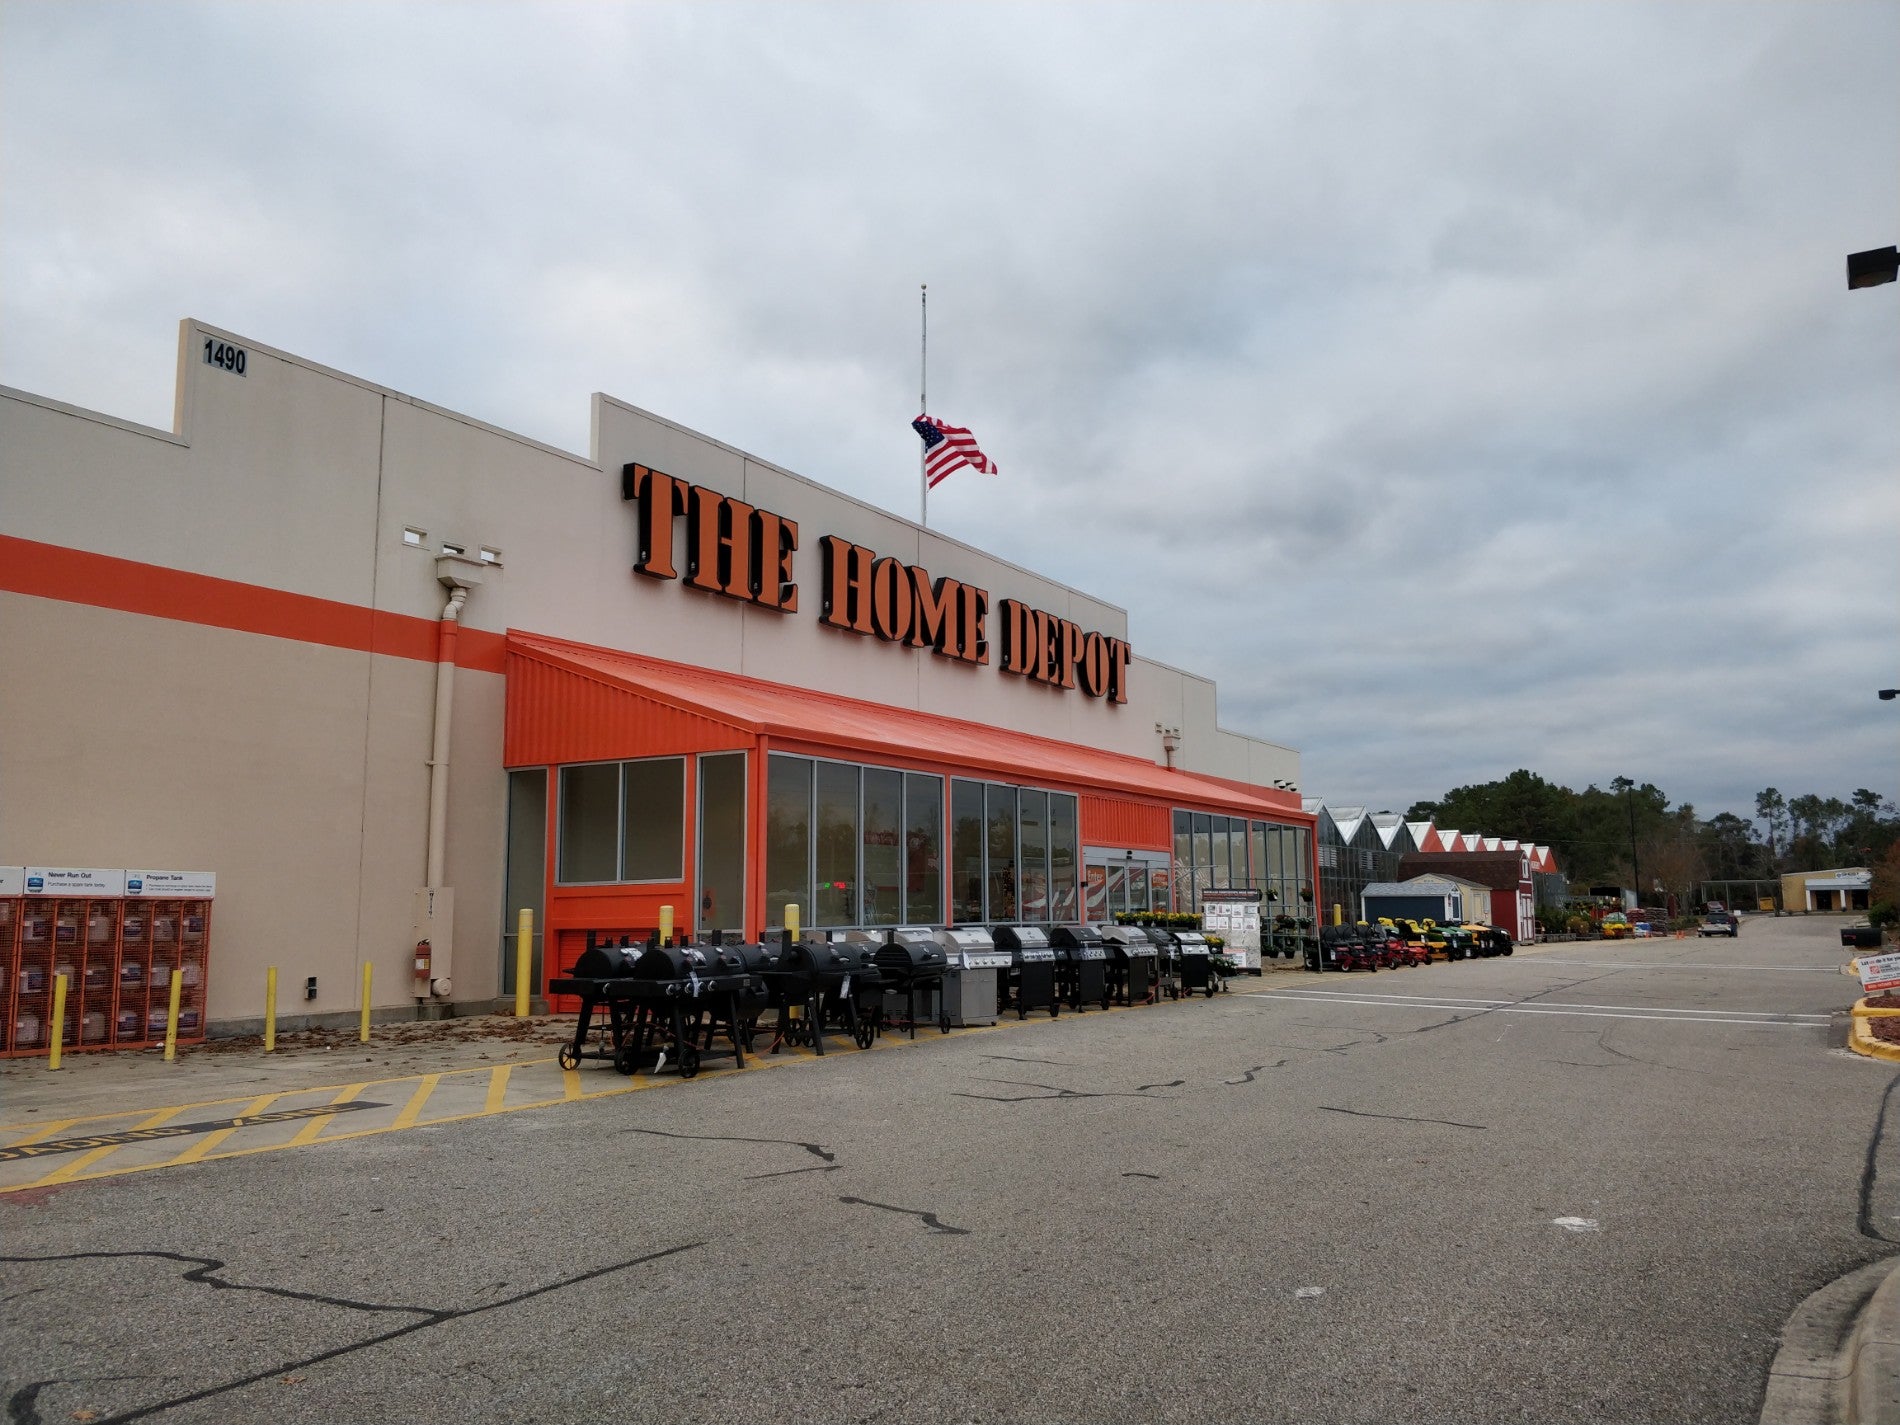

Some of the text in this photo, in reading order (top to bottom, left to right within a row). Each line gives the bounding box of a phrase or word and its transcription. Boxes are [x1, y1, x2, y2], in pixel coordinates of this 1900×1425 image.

[204, 338, 246, 374] 1490
[622, 462, 1132, 705] THE HOME DEPOT
